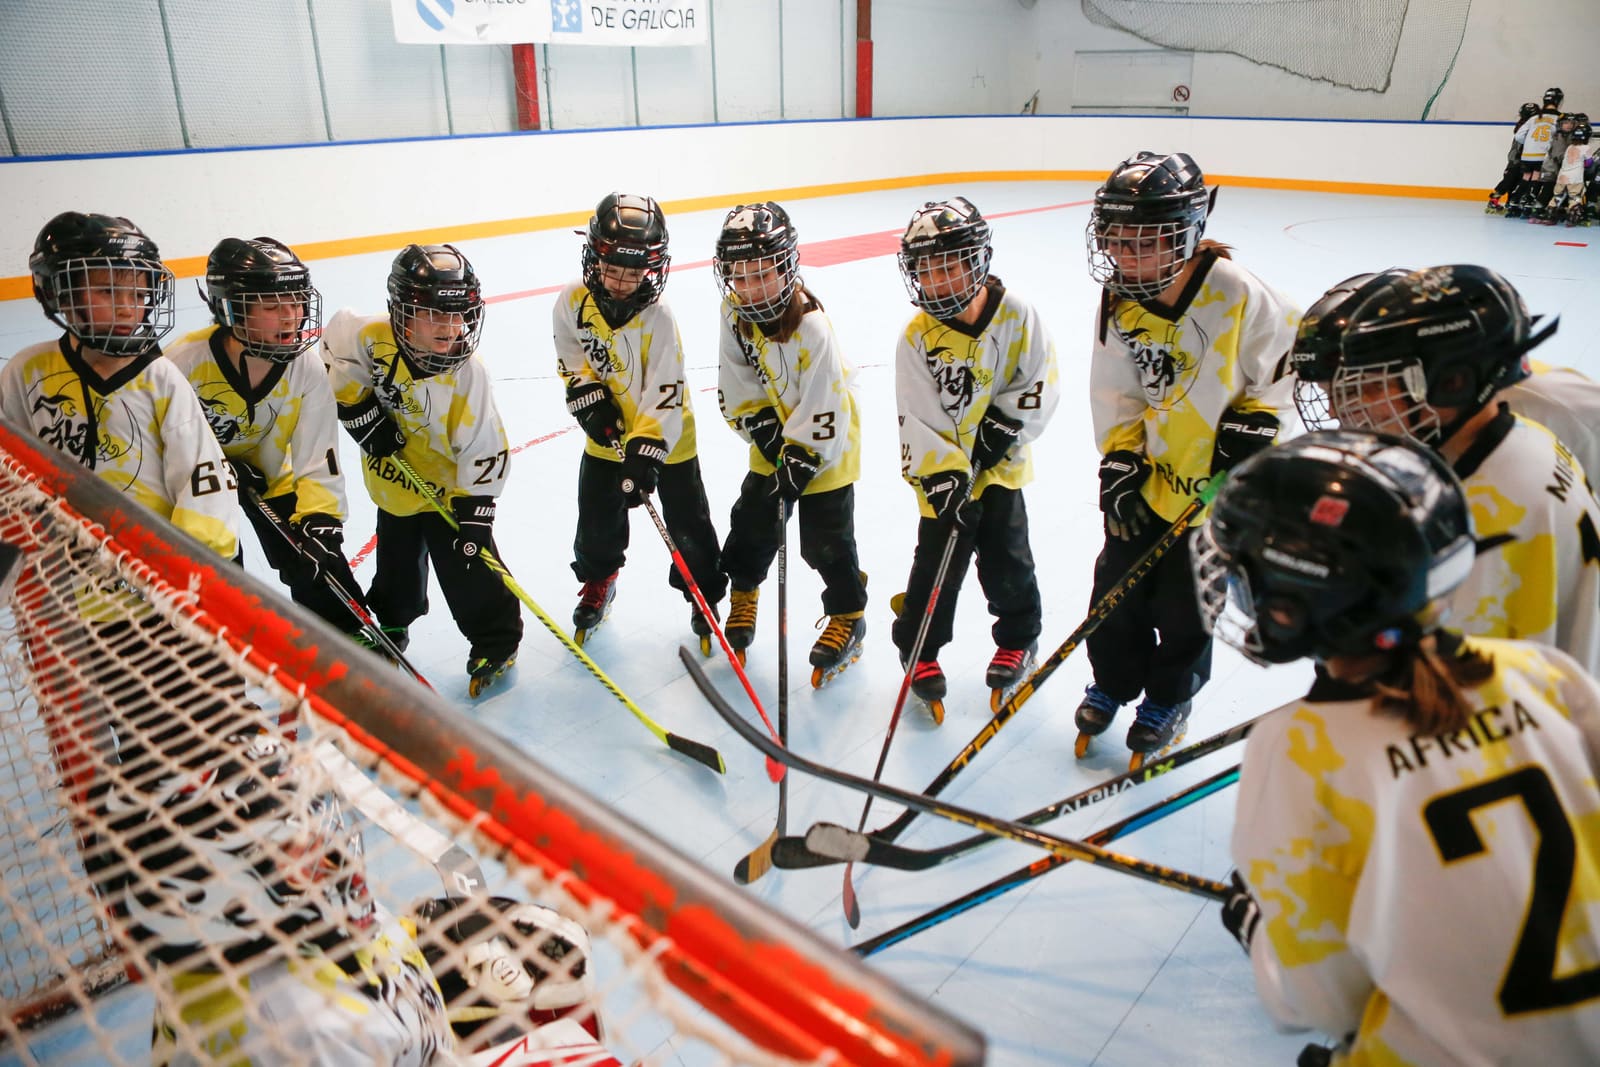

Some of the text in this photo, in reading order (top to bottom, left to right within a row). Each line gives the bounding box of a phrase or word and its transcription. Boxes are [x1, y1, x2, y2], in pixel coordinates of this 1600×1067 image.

[591, 6, 694, 29] DE GALICIA
[616, 247, 645, 256] CCM
[438, 289, 466, 297] CCM
[812, 411, 836, 441] 3
[325, 447, 340, 476] 1
[472, 449, 508, 485] 27
[611, 440, 626, 462] CC
[191, 458, 238, 498] 63
[951, 682, 1034, 768] TRUE
[1385, 699, 1540, 780] AFRICA
[1058, 777, 1138, 817] ALPHA
[1422, 762, 1600, 1018] 2
